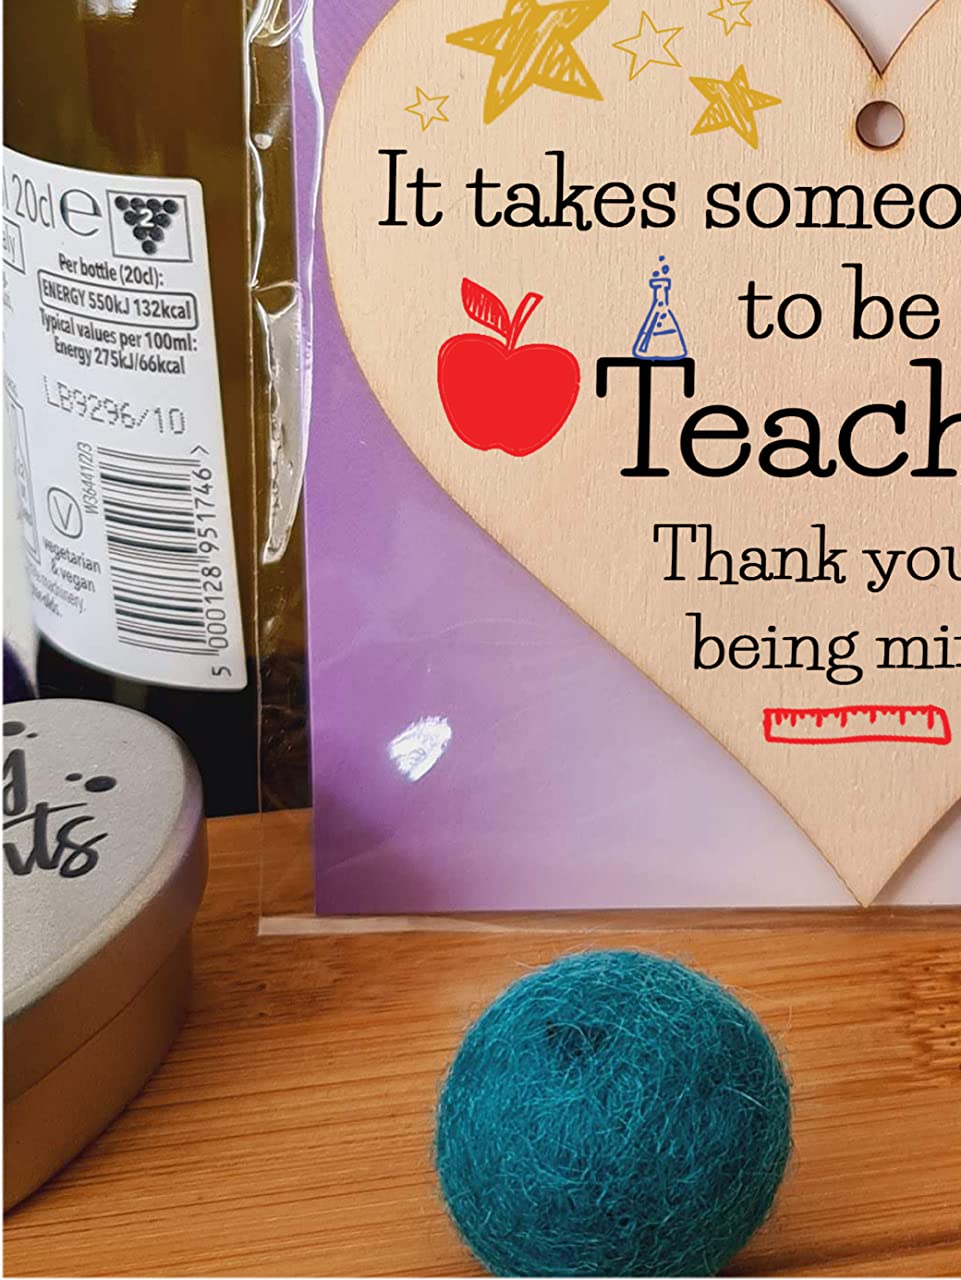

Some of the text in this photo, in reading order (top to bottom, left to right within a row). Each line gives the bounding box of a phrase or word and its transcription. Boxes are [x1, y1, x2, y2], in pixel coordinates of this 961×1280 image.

[12, 174, 55, 229] 20cl
[378, 150, 442, 228] It
[466, 150, 676, 231] takes
[58, 252, 164, 288] Per bottle (20cl):
[42, 278, 86, 306] ENERGY
[89, 286, 131, 315] 550kJ
[133, 298, 191, 320] 132kcal
[738, 280, 822, 339] to
[842, 263, 941, 339] be
[40, 307, 198, 352] Typical values per 100ml:
[54, 335, 186, 375] Energy 275kJ/66kcal
[192, 468, 220, 554] 951746
[43, 536, 101, 574] vegetarian
[60, 567, 96, 592] vegan
[654, 523, 848, 586] Thank
[202, 566, 229, 650] 000128
[686, 612, 864, 686] being
